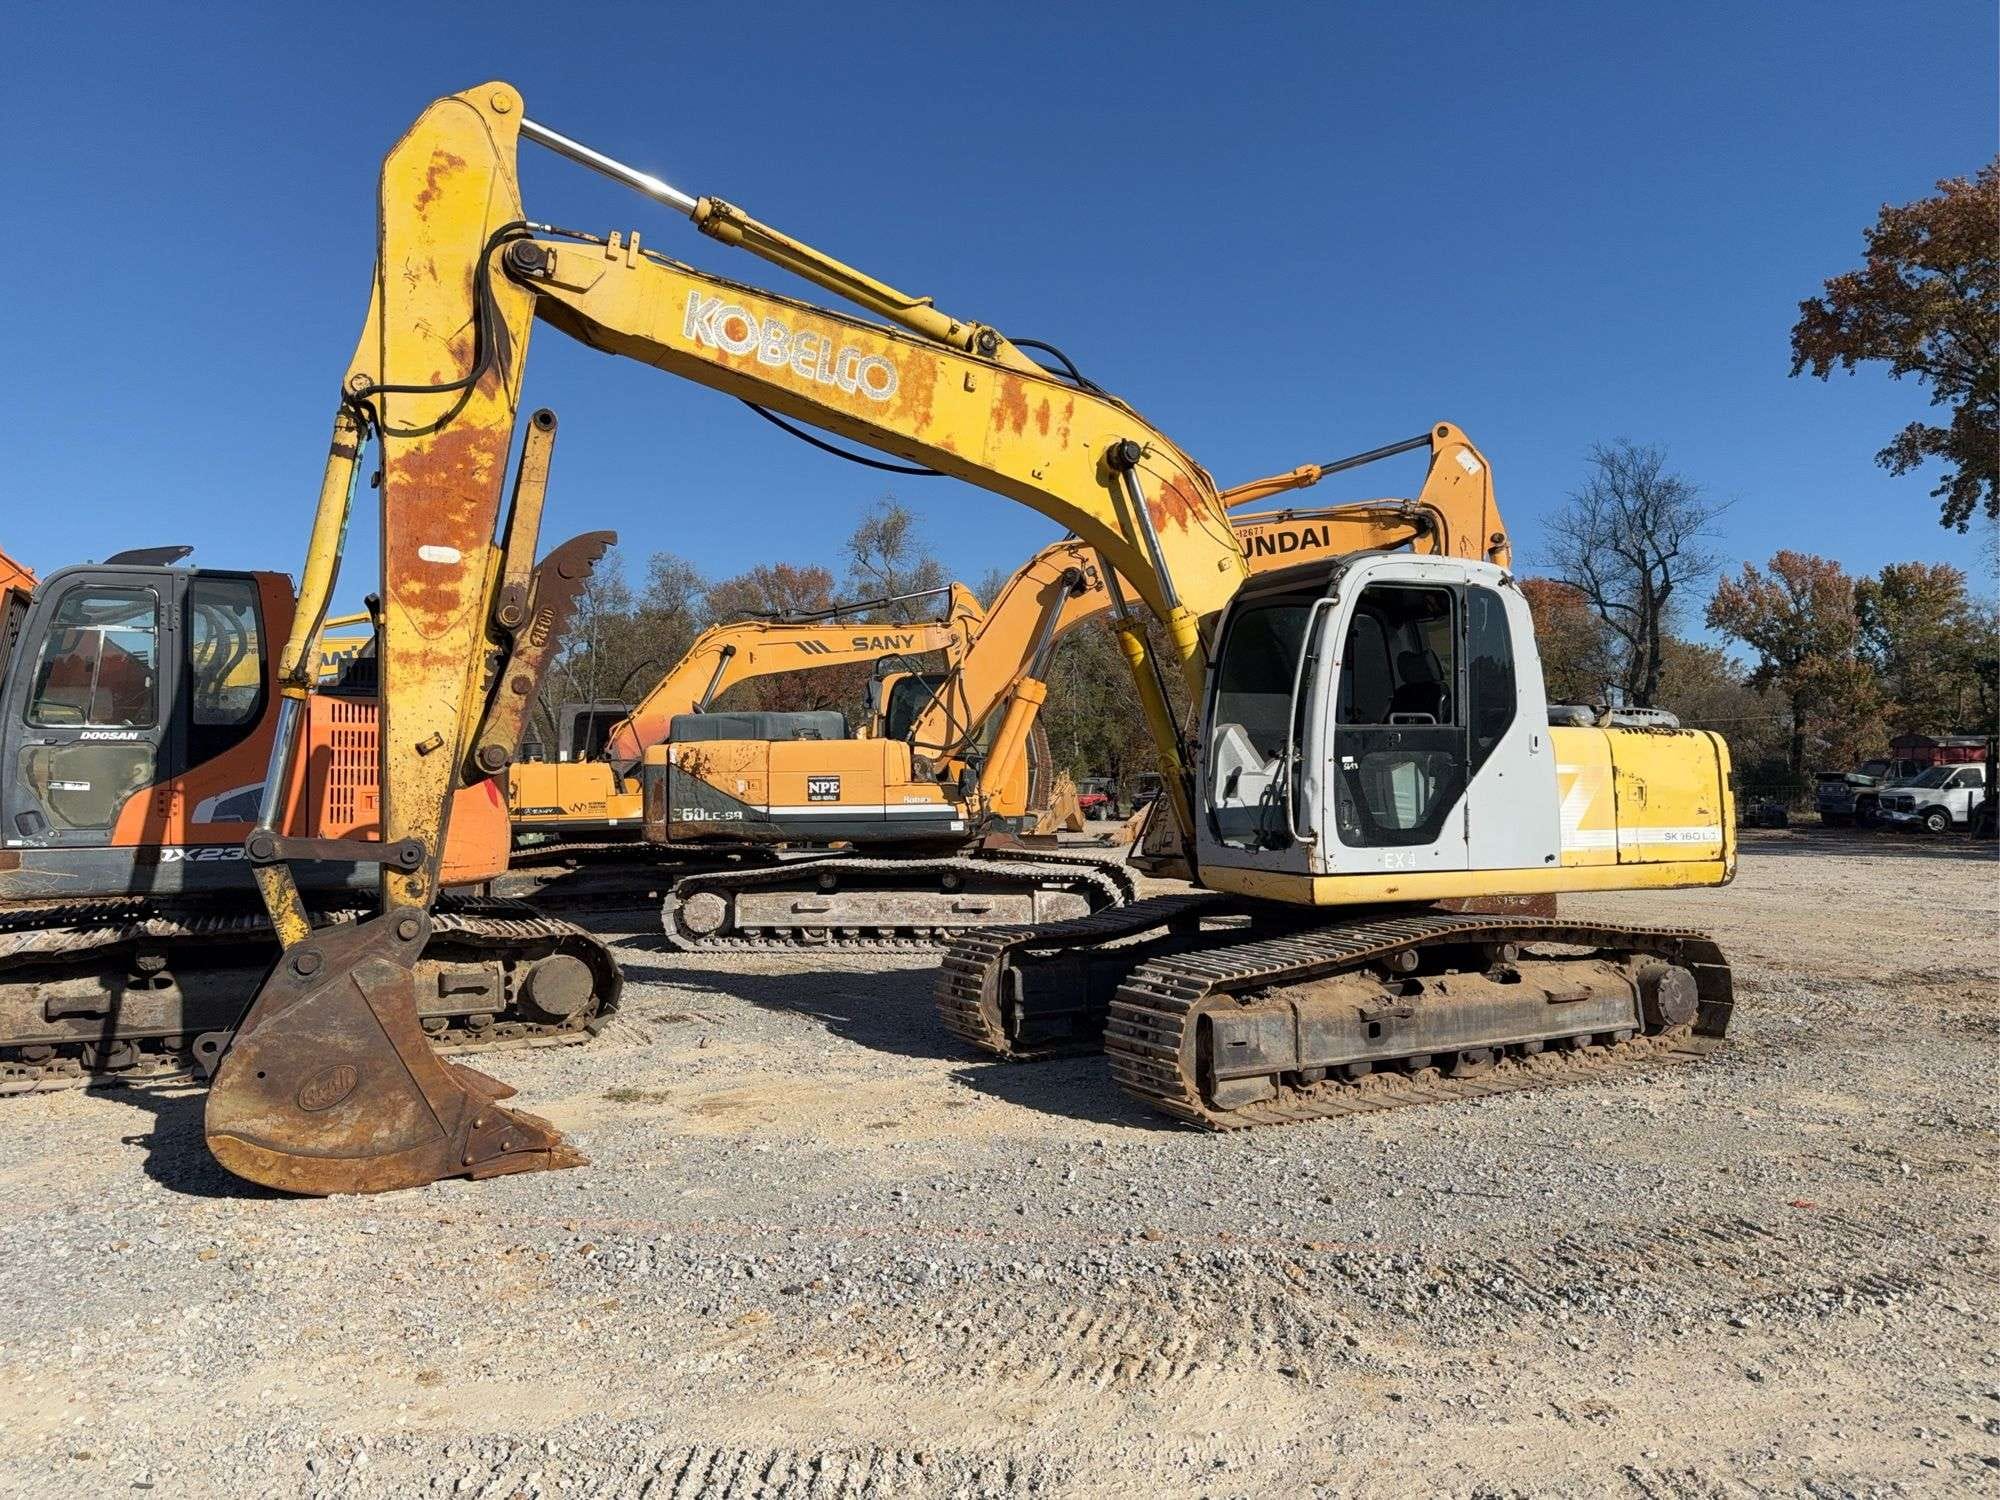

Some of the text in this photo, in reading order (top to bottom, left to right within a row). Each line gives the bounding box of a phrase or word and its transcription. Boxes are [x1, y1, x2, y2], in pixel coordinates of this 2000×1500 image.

[683, 290, 898, 401] KOBELCO
[1242, 525, 1330, 559] UNDAI
[852, 634, 914, 652] SANY
[80, 732, 138, 740] DOOSAN
[808, 781, 840, 794] NPE
[1664, 832, 1678, 841] SK
[159, 847, 250, 862] DX23
